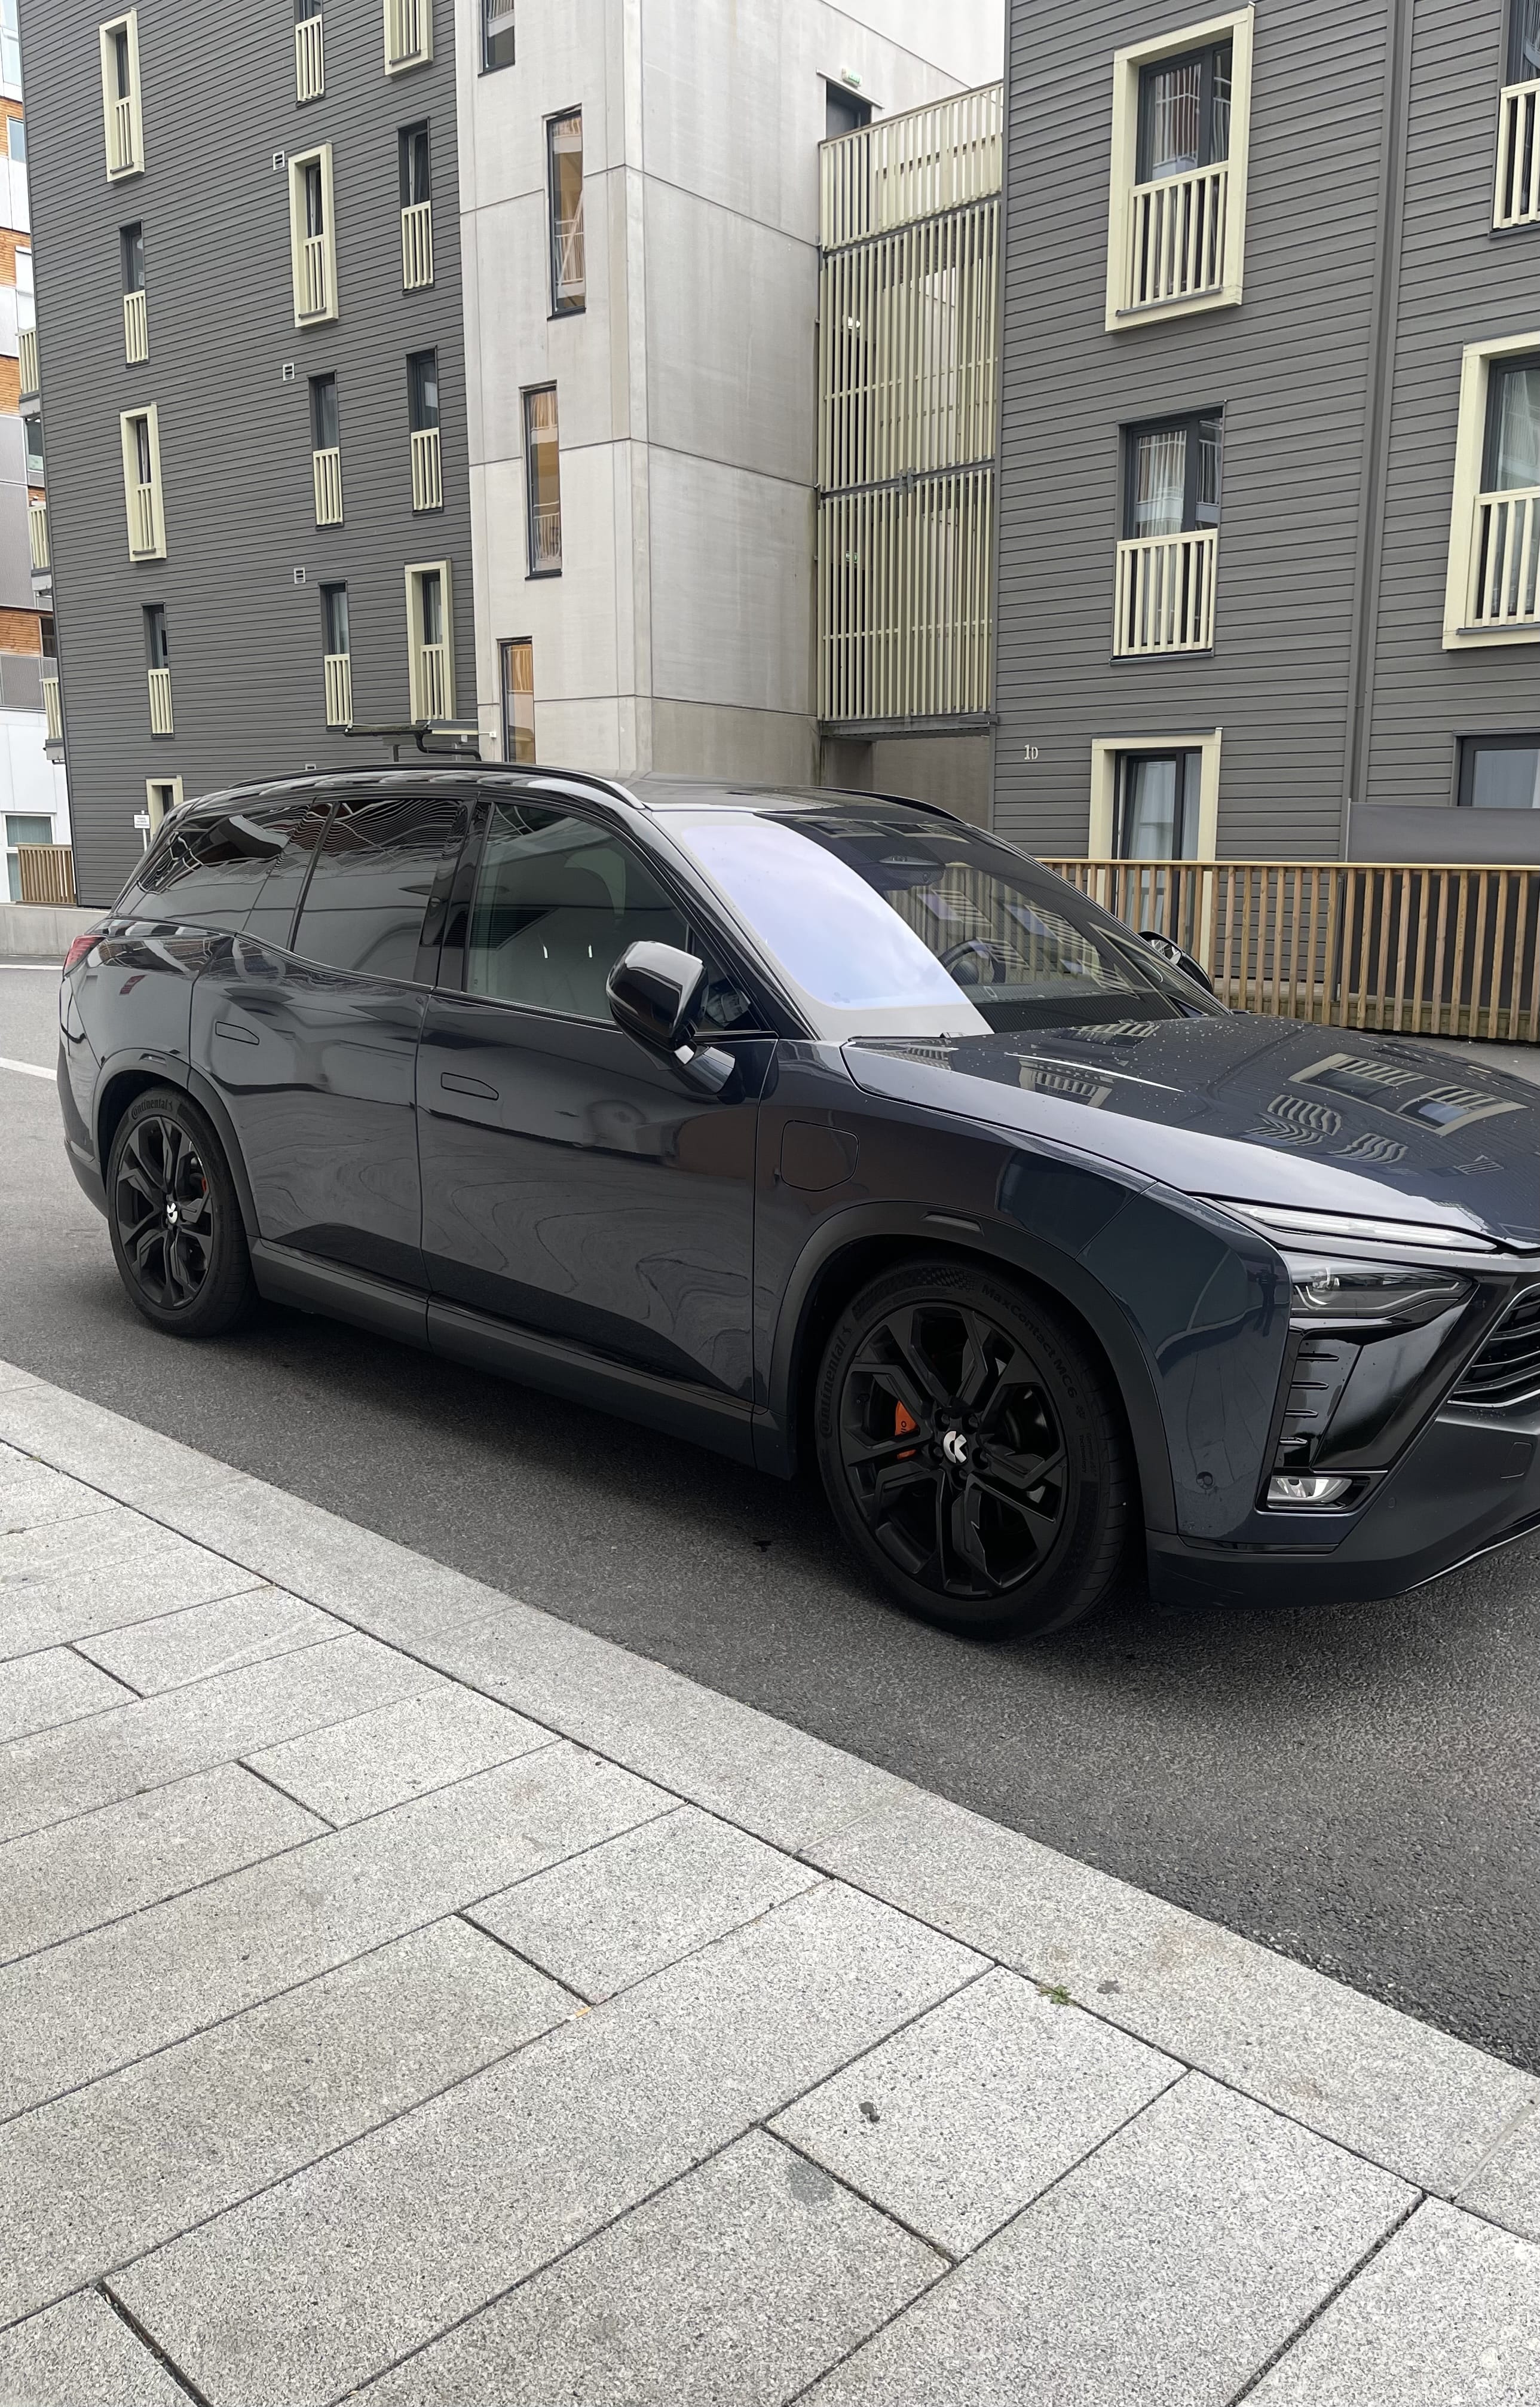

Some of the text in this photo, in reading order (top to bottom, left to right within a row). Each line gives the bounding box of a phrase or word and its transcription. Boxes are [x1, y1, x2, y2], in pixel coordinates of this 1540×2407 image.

[1024, 744, 1039, 760] 1D
[131, 1098, 168, 1120] Continental
[981, 1284, 1077, 1398] MaxContact MC6
